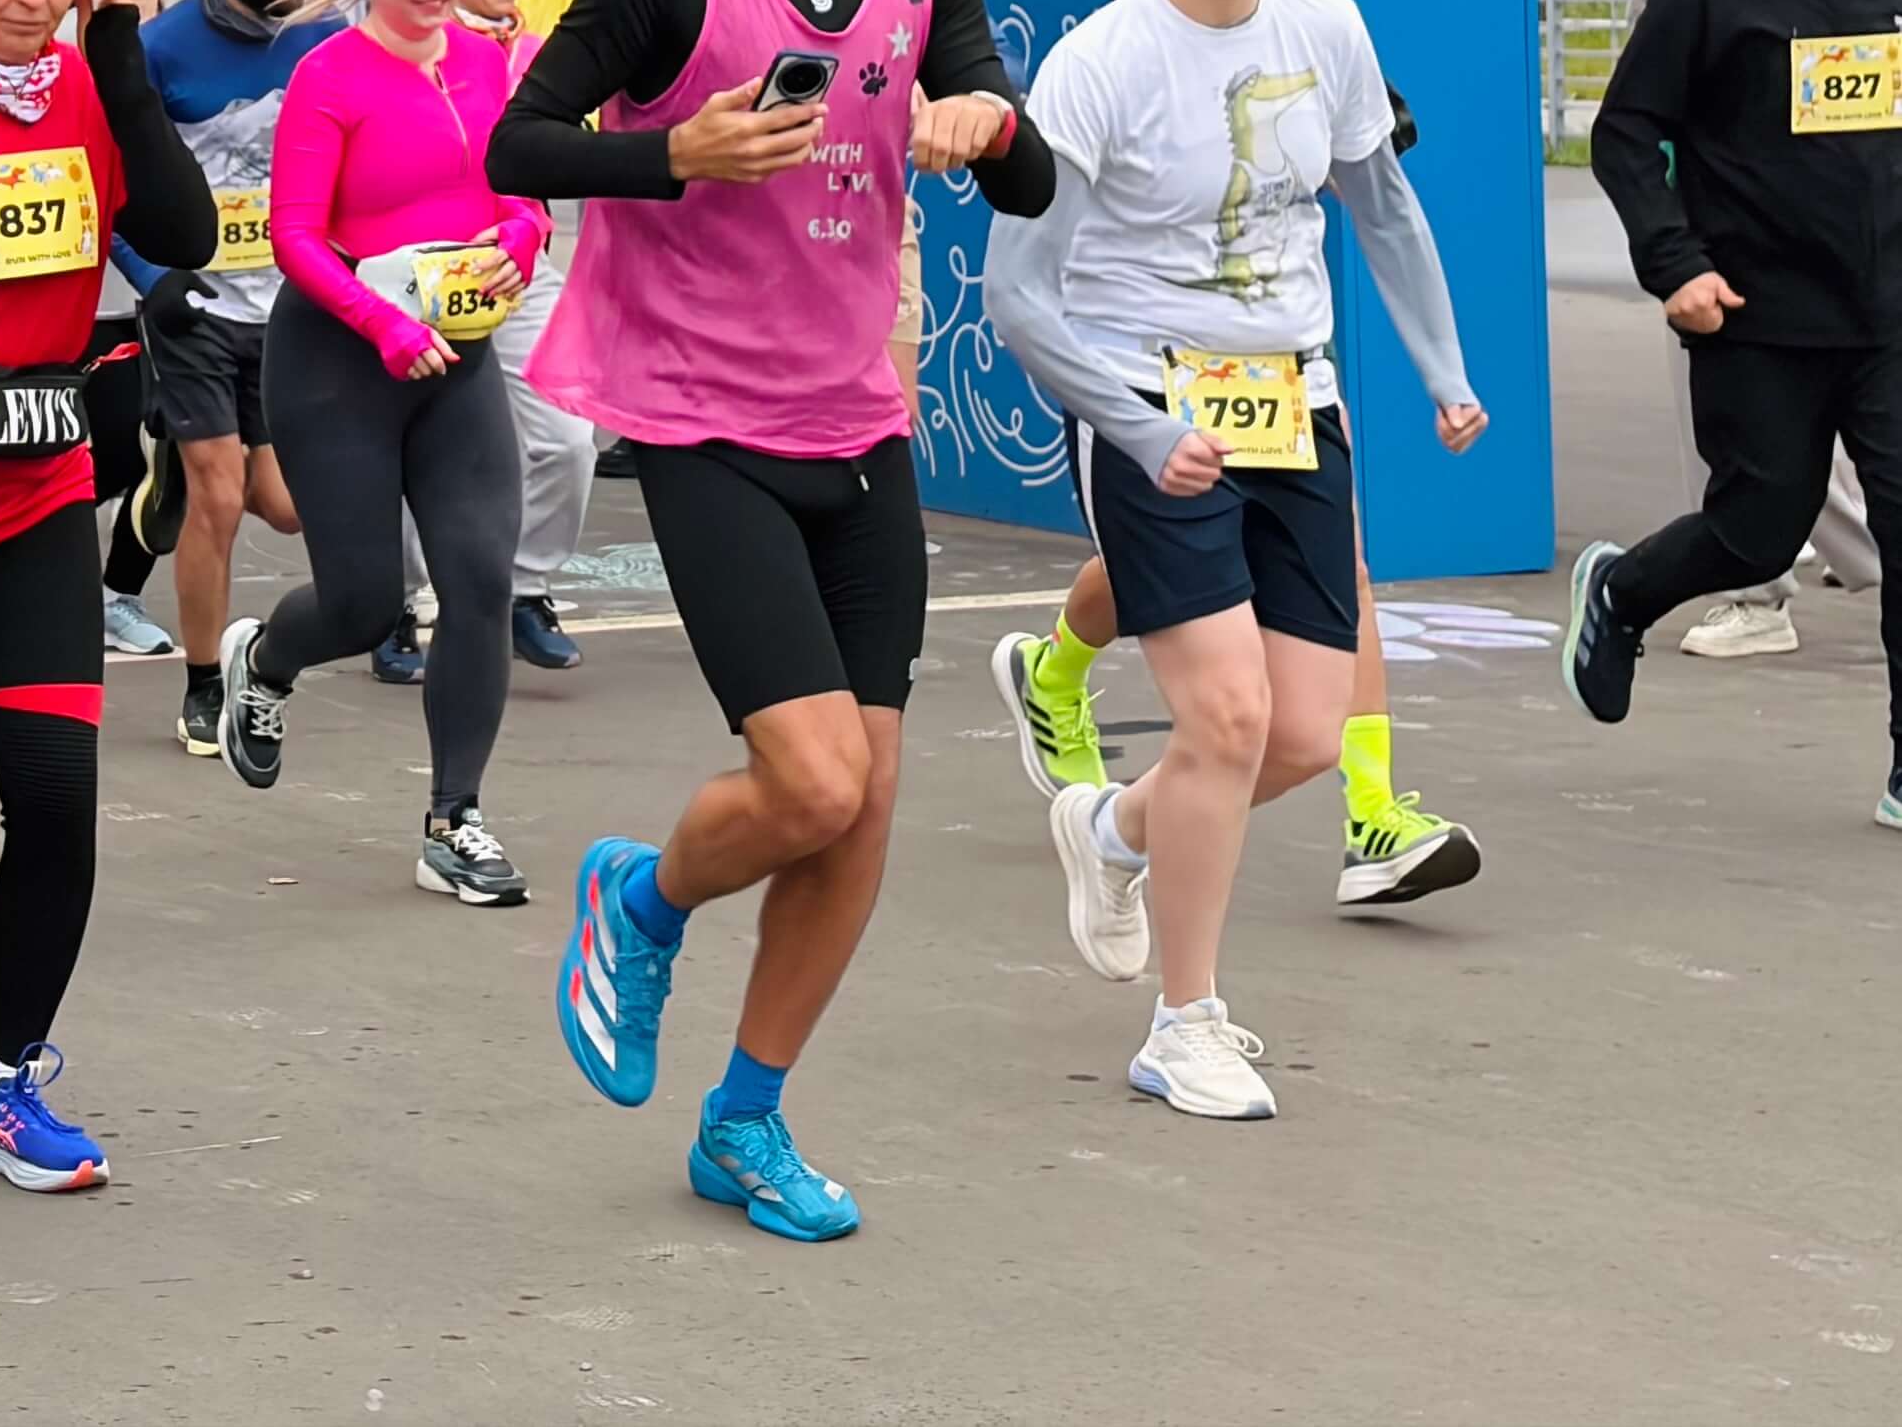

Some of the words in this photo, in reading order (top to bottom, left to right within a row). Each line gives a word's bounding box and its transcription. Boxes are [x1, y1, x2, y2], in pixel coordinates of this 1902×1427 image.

[1824, 73, 1880, 101] 827
[809, 142, 863, 164] WITH
[0, 198, 65, 238] 837
[1203, 396, 1279, 429] 797
